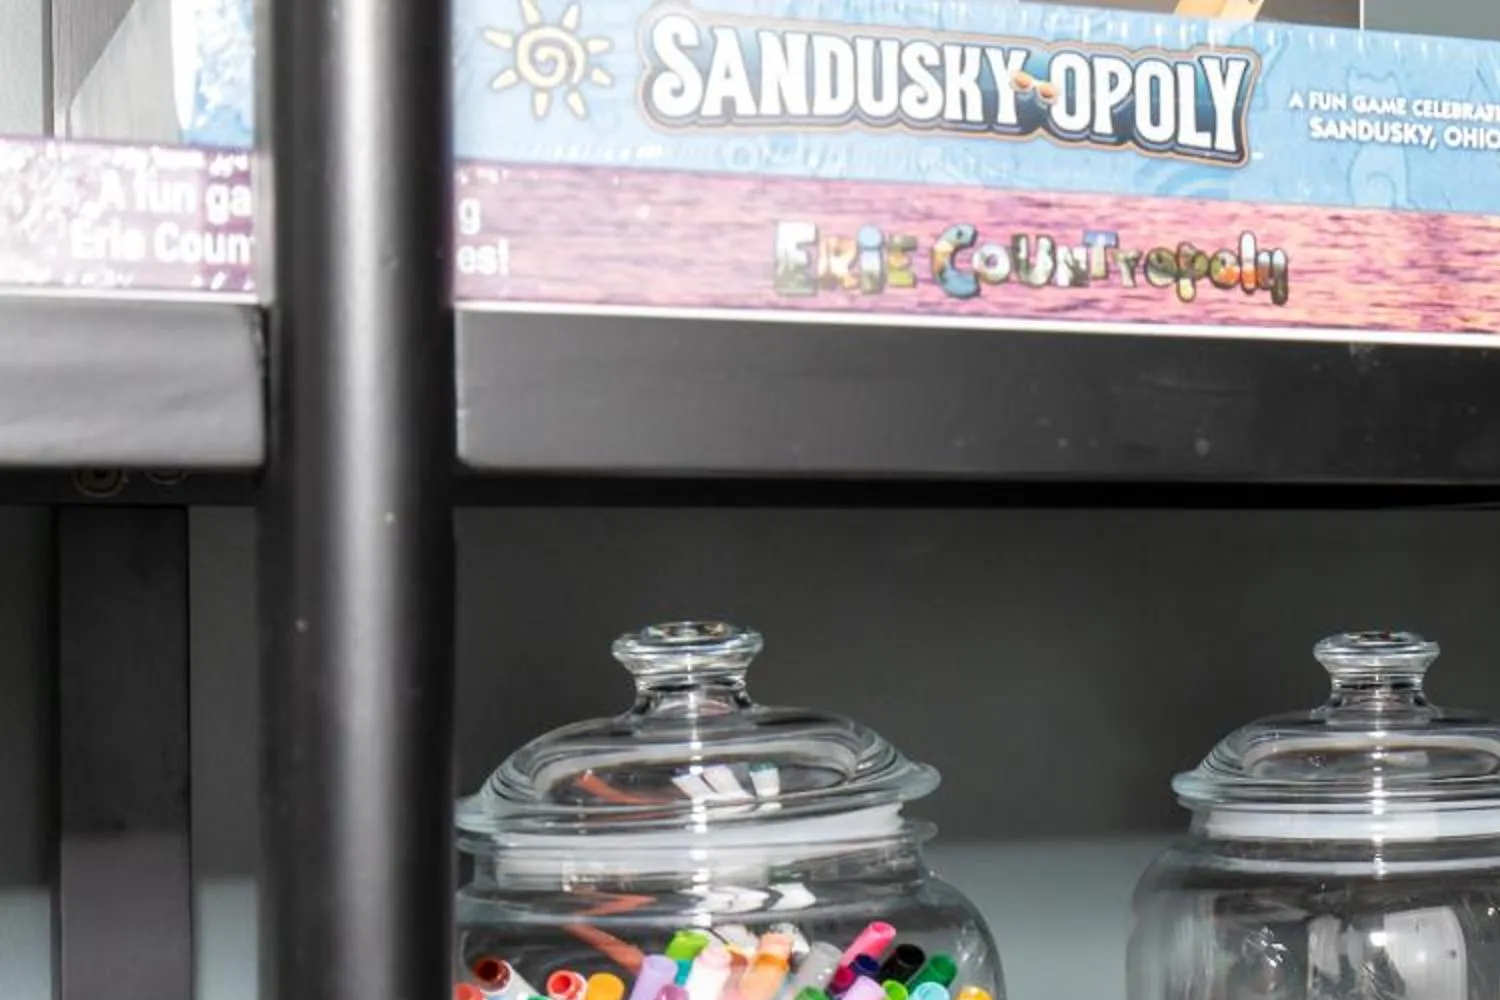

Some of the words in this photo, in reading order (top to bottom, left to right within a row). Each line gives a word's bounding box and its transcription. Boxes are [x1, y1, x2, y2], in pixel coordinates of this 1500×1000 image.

[651, 14, 1026, 125] SANDUSKY
[1288, 90, 1304, 109] A
[1309, 92, 1348, 112] FUN
[1353, 95, 1407, 116] GAME
[1309, 116, 1438, 149] SANDUSKY,
[205, 182, 251, 225] ga
[154, 221, 252, 265] Coun
